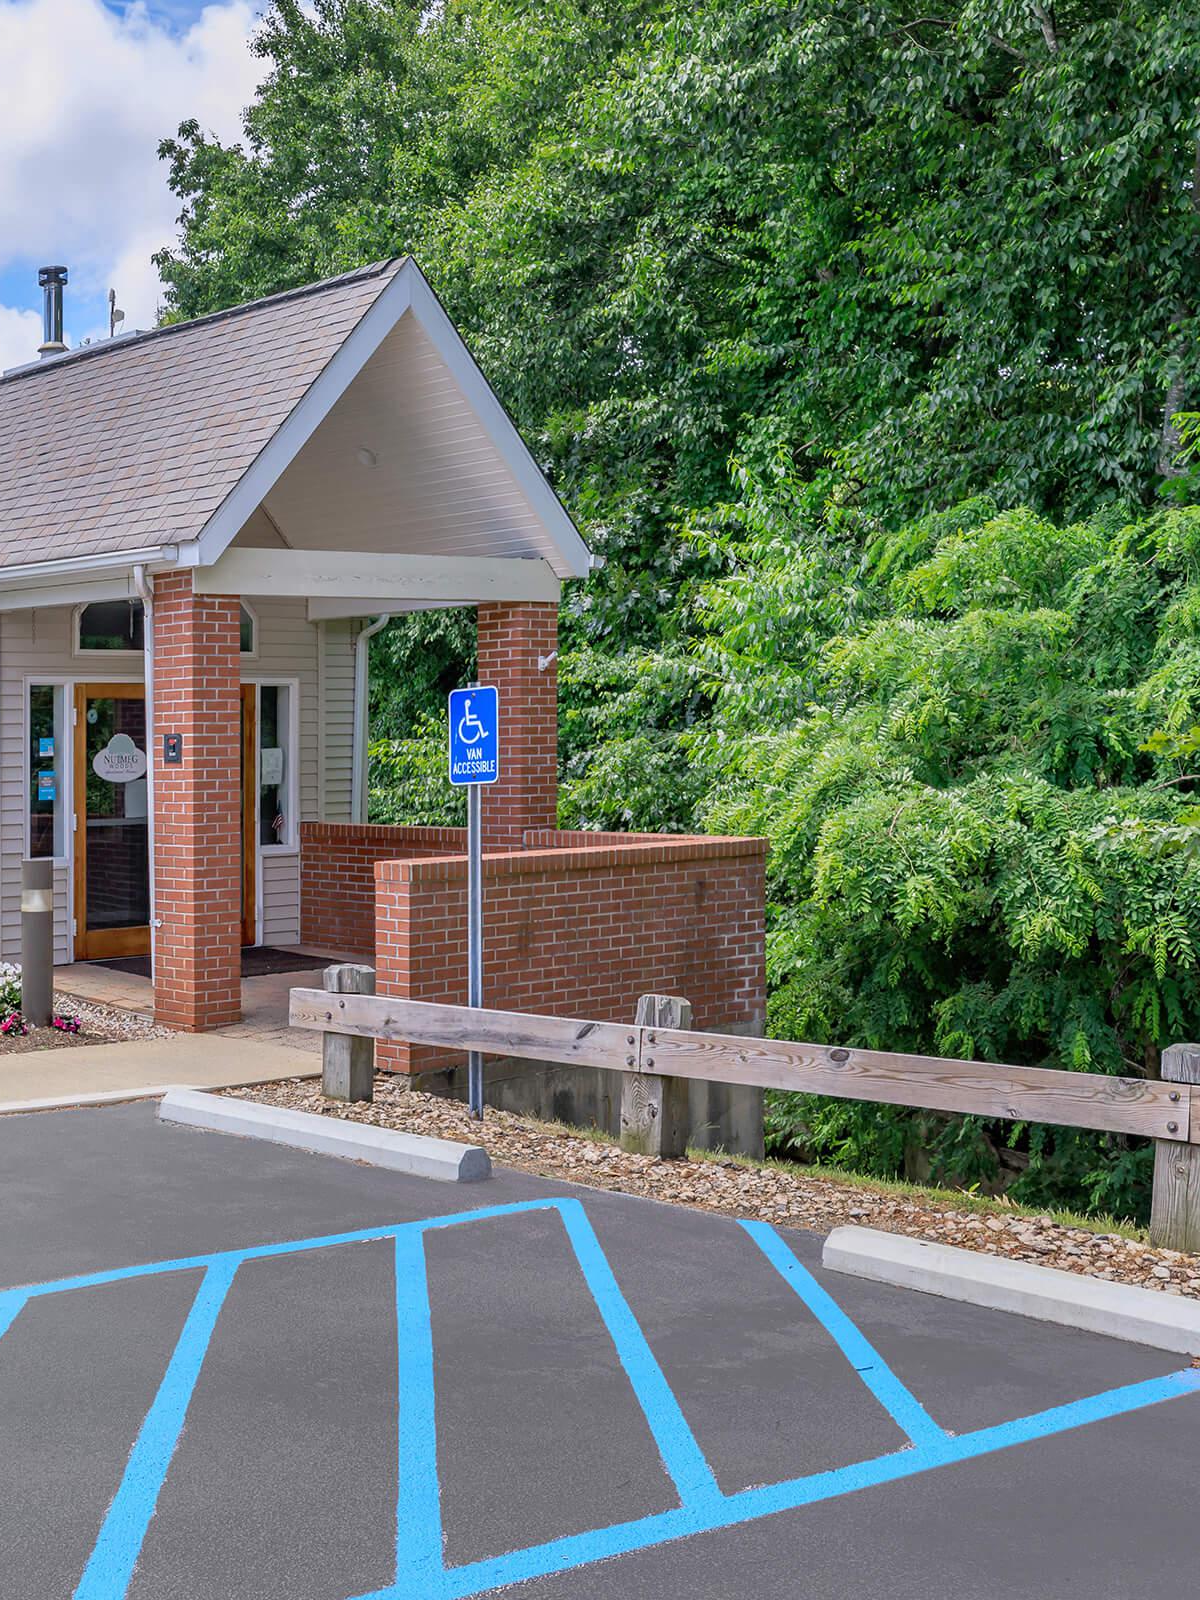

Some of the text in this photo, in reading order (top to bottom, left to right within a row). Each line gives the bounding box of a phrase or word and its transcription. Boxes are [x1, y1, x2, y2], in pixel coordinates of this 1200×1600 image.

[103, 754, 138, 764] NUTMEG
[466, 747, 482, 760] VAN
[453, 760, 495, 775] ACCESSIBLE
